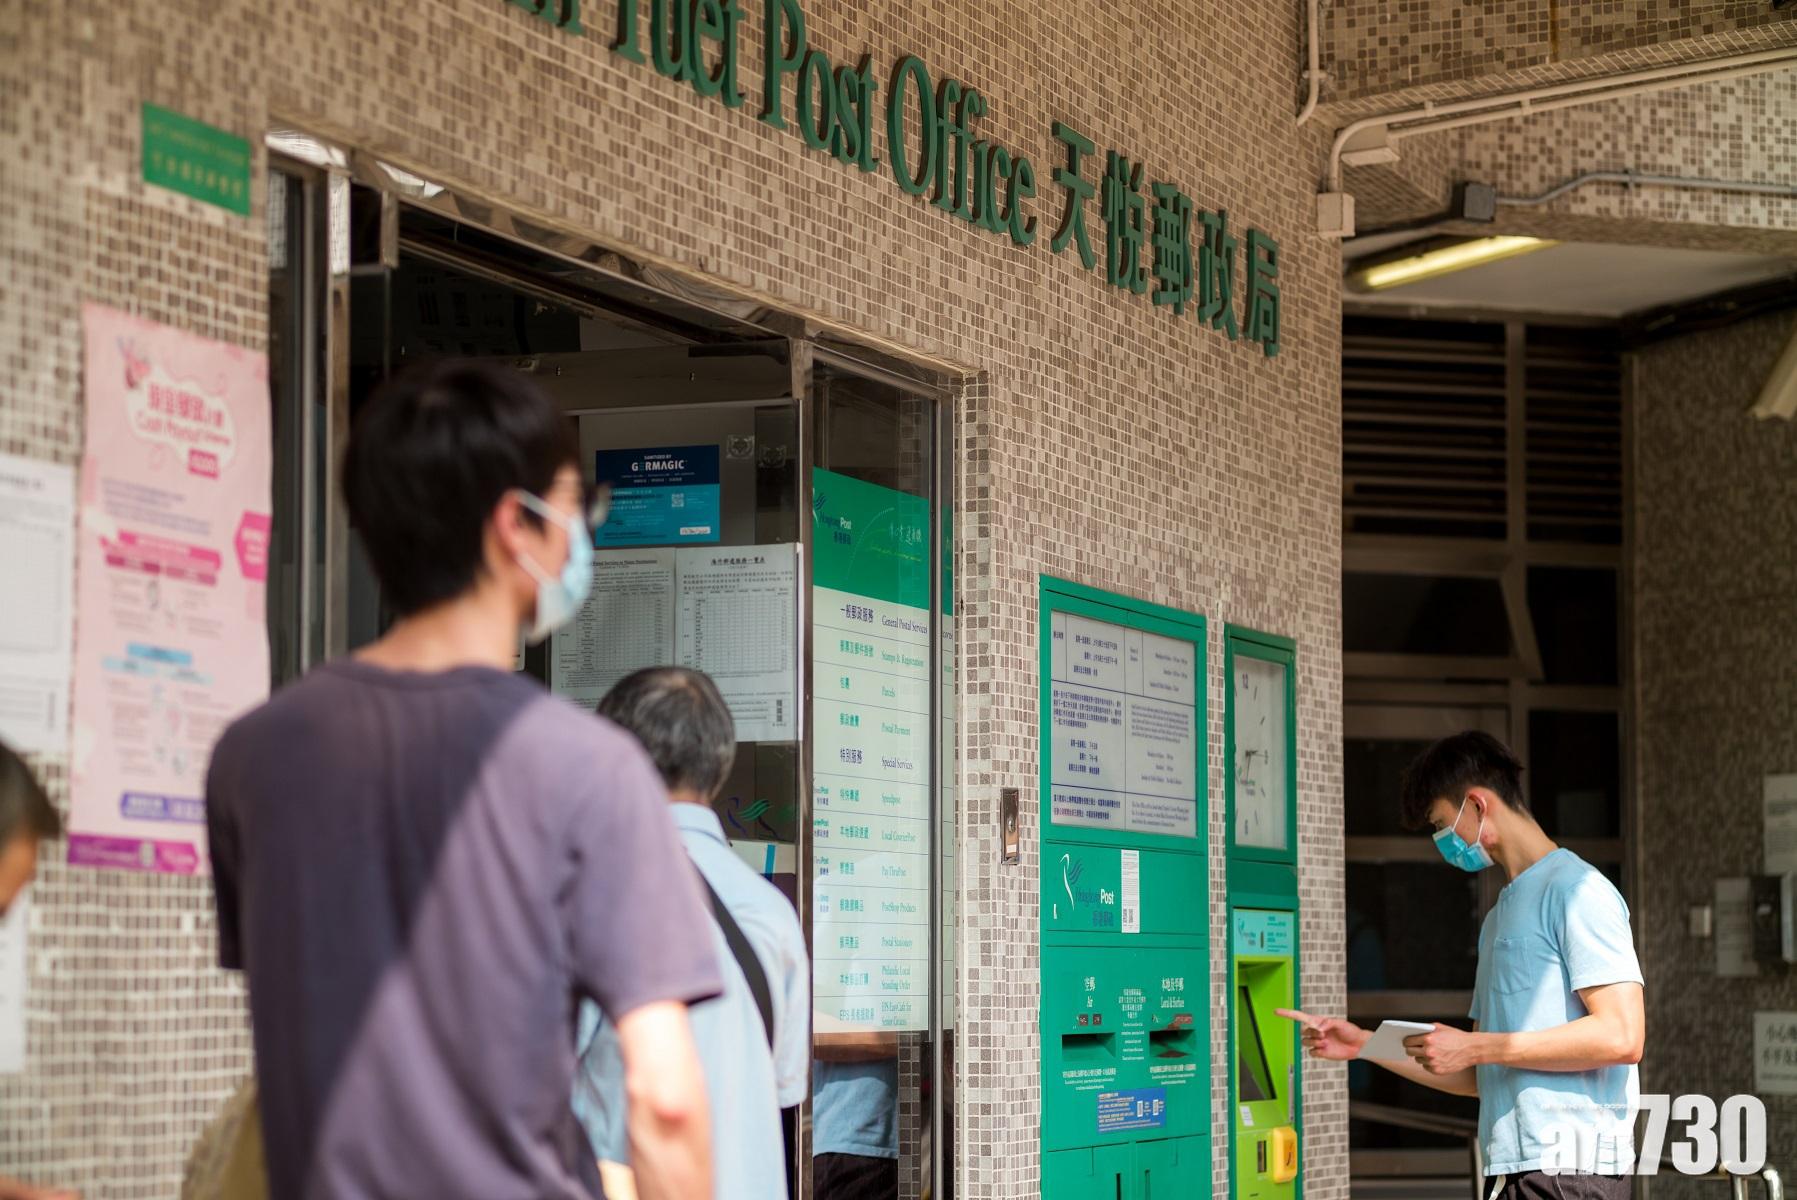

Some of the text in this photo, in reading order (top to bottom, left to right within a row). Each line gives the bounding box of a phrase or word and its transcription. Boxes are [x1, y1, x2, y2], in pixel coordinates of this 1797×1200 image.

[758, 0, 879, 172] Post
[888, 56, 1037, 246] Office
[1051, 121, 1281, 357] 天悅郵政局
[882, 615, 928, 634] General Postal Services
[882, 756, 913, 770] Special Services
[1100, 888, 1114, 905] Post
